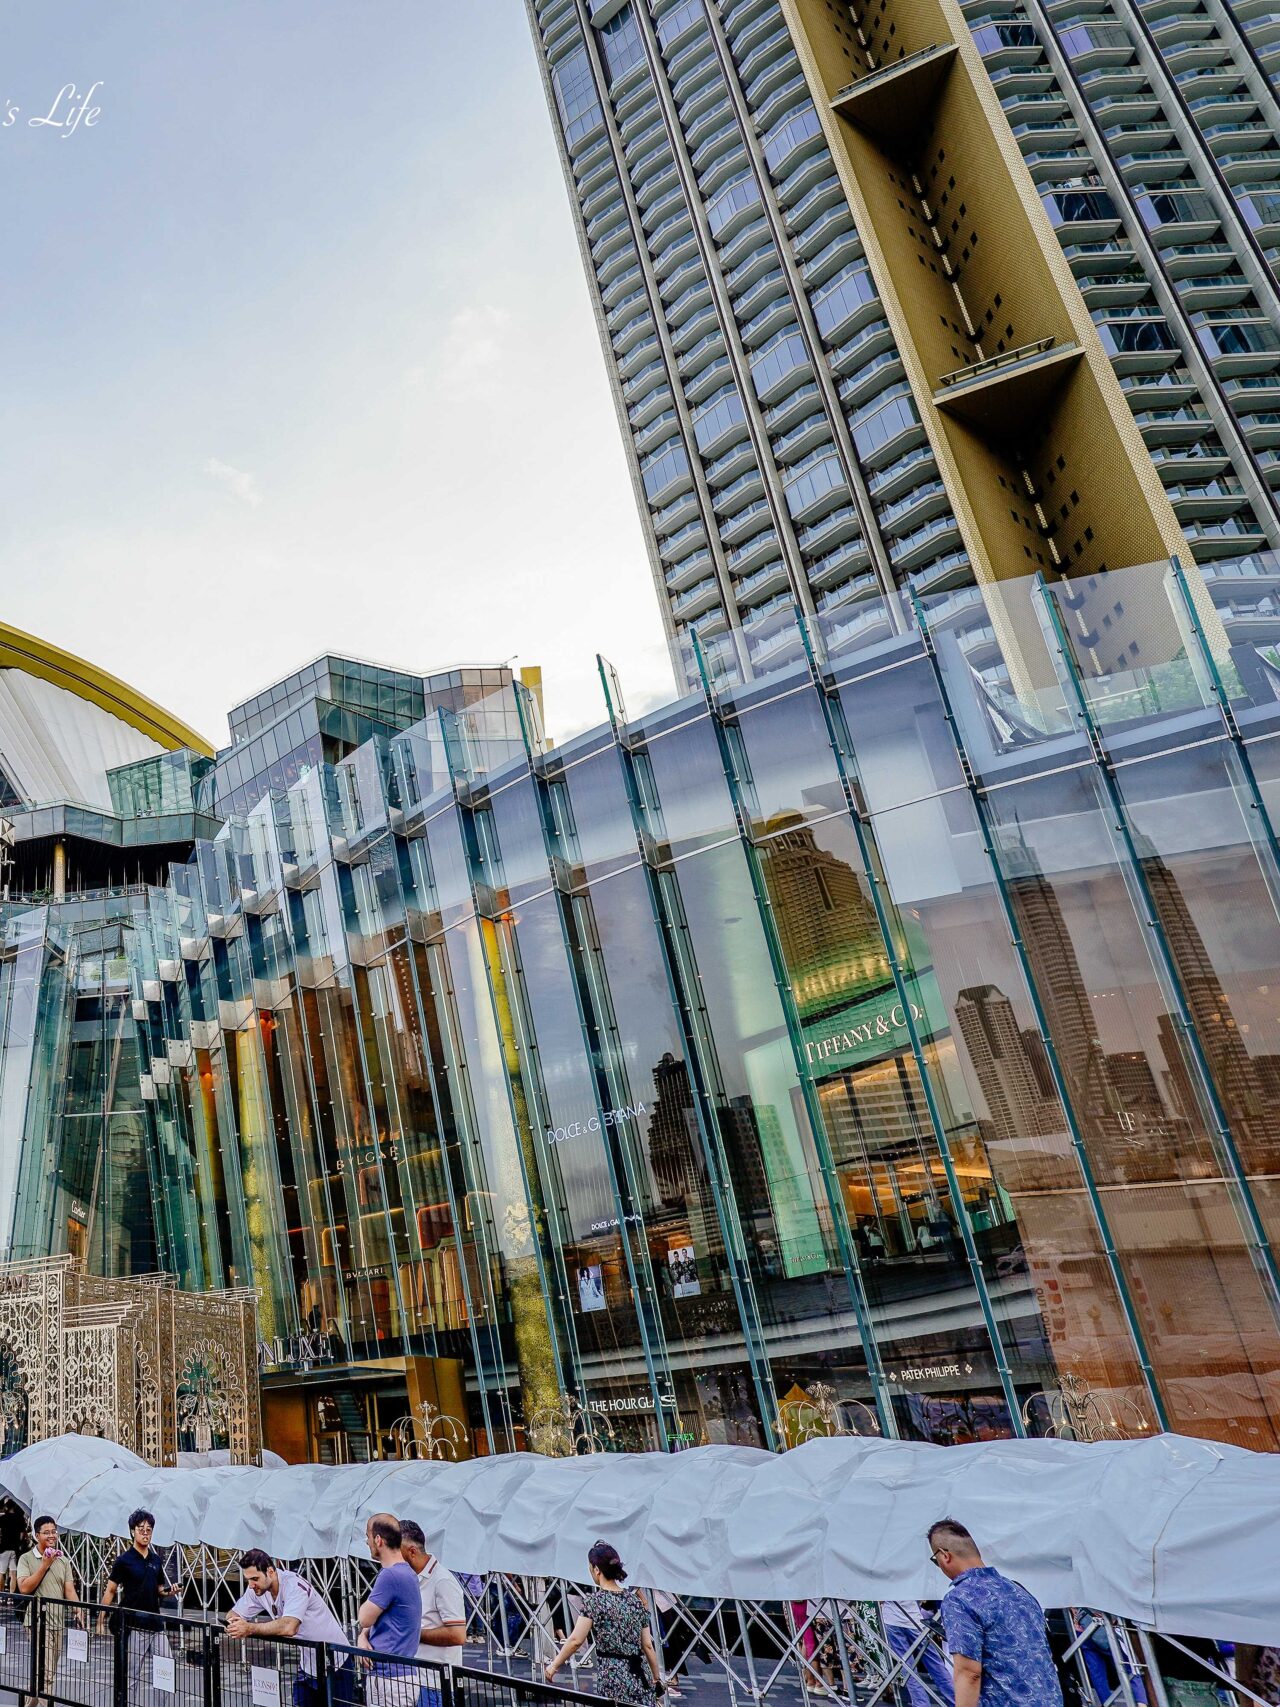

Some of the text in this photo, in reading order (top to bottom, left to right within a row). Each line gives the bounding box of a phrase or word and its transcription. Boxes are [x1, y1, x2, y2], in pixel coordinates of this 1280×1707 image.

[805, 1021, 873, 1063] TIFFANY
[876, 1015, 891, 1035] &
[547, 1101, 647, 1144] DOLCE & GBANA
[591, 1220, 608, 1230] DOLCE
[1036, 1287, 1047, 1308] OUT
[256, 1333, 332, 1366] NLUXE
[901, 1364, 960, 1380] PATEK PHILIPPE
[590, 1399, 608, 1412] THE
[609, 1397, 638, 1411] HOUR
